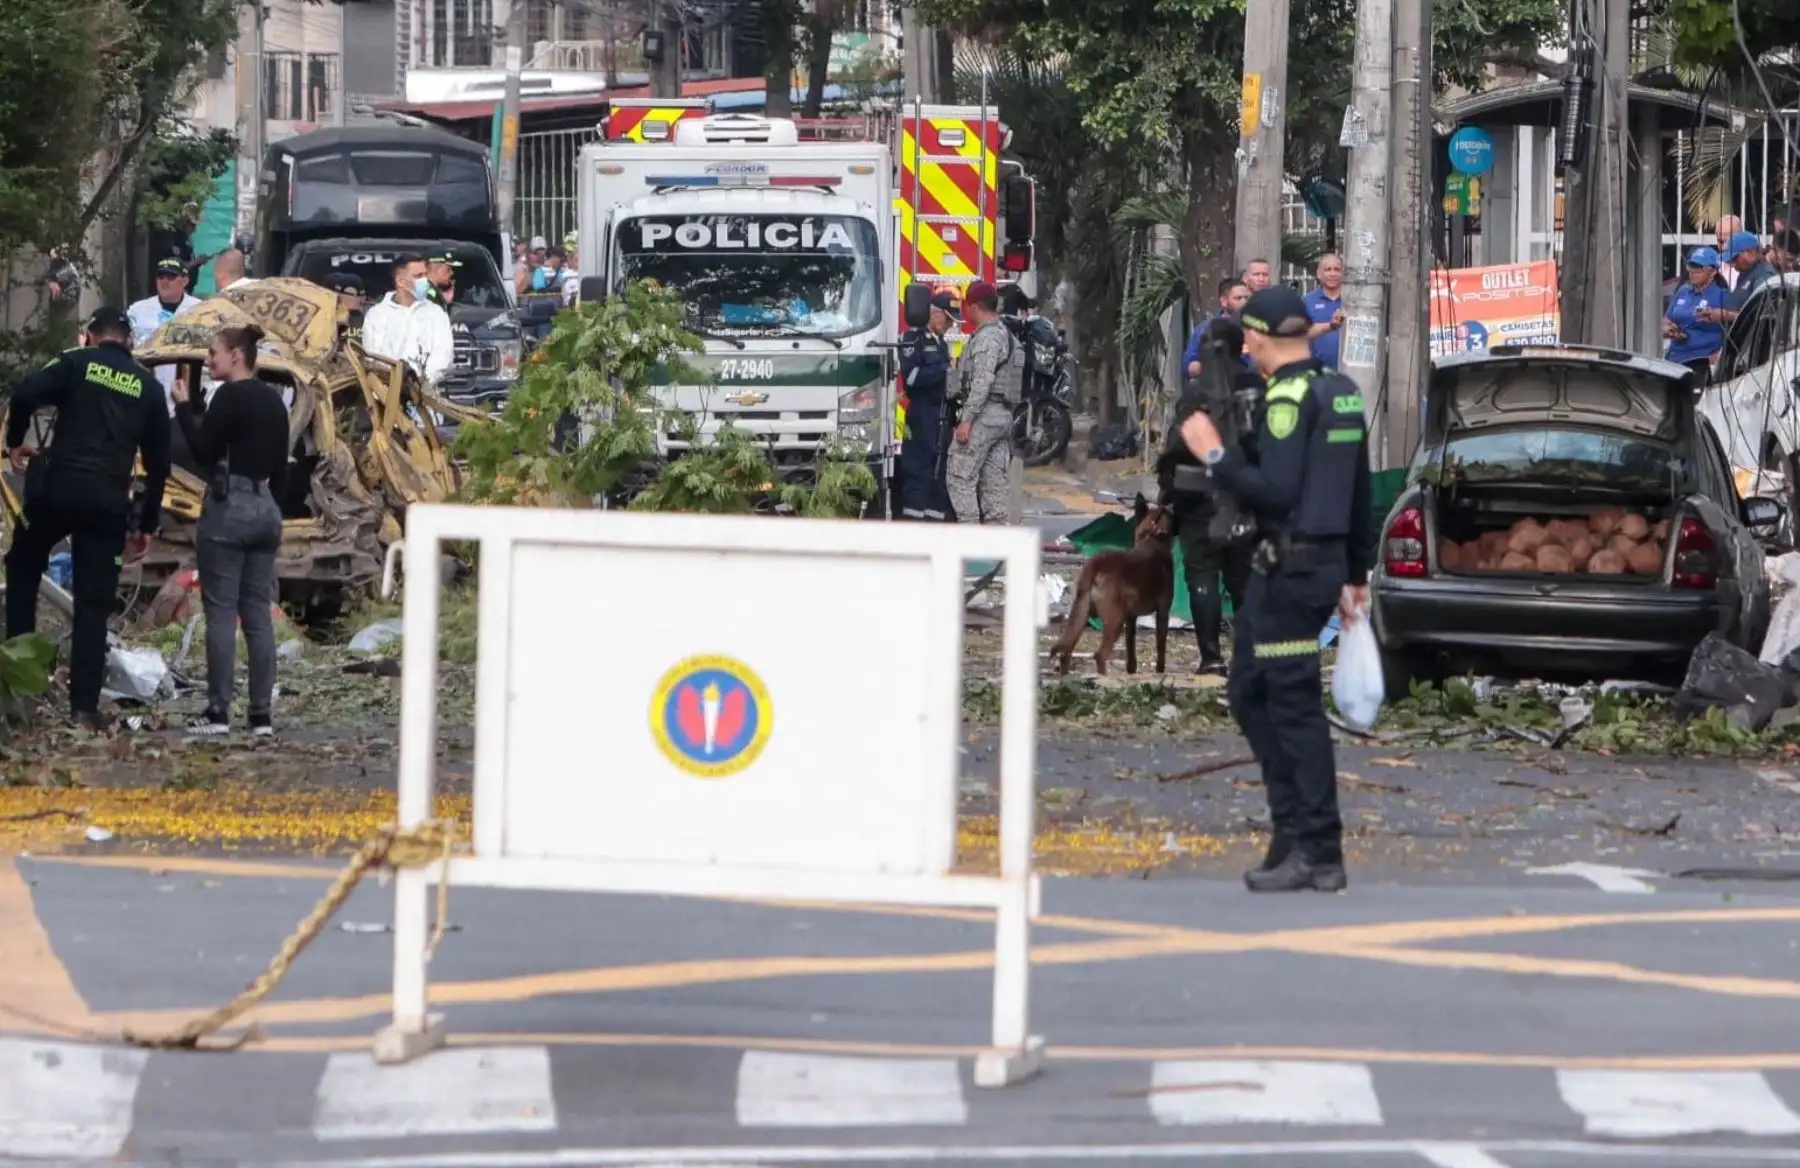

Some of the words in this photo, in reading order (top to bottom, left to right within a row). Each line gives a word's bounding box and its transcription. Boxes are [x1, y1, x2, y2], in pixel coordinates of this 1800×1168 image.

[641, 217, 854, 249] POLICÍA
[1482, 269, 1530, 290] OUTLET
[256, 292, 309, 328] 363
[1500, 320, 1555, 333] CAMISETAS
[1470, 333, 1482, 350] 3
[721, 359, 774, 380] 27-2940
